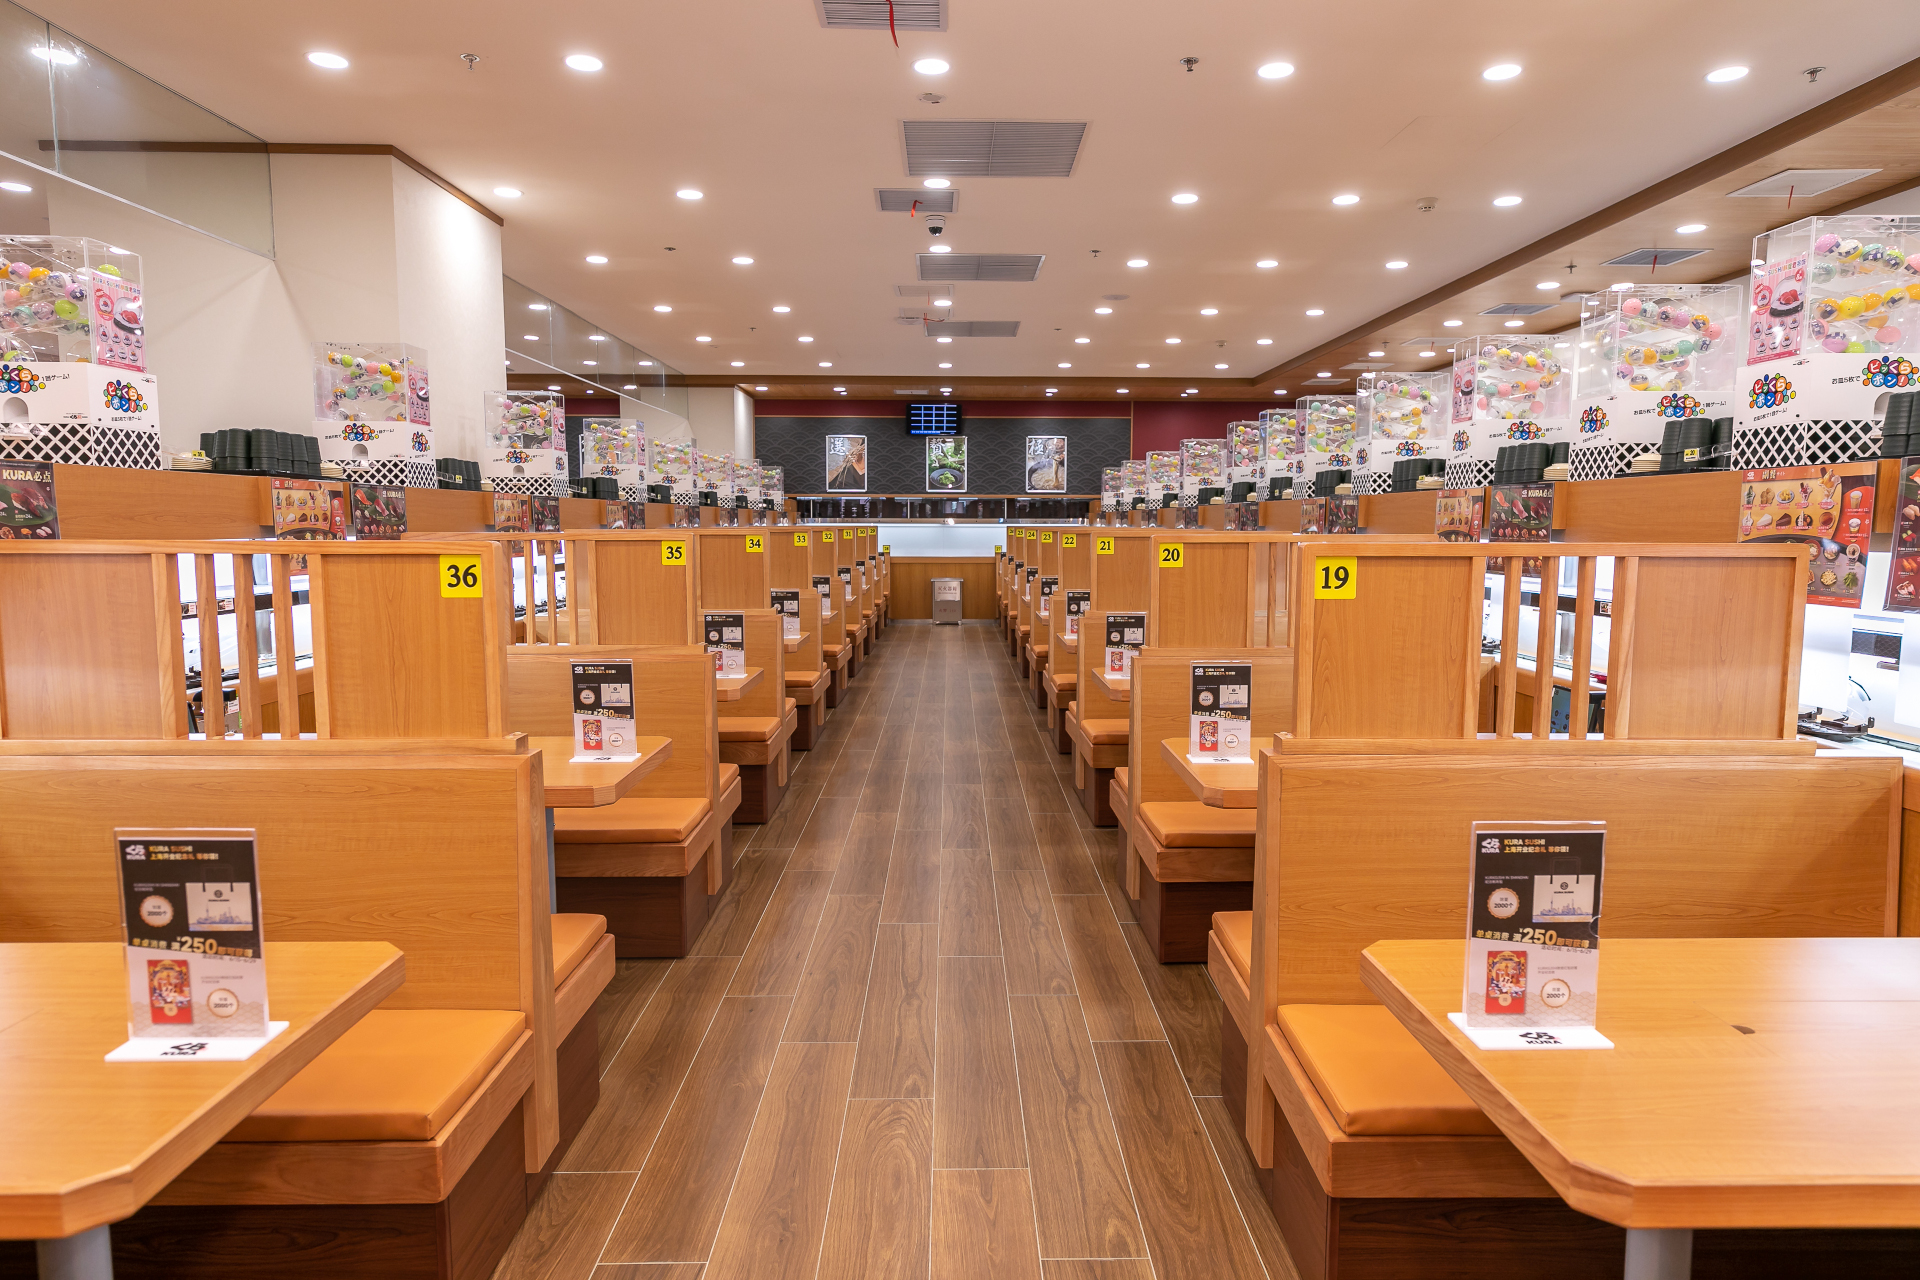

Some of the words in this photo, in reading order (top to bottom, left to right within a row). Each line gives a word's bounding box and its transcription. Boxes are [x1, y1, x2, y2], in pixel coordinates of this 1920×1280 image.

[1870, 361, 1910, 373] ビッくら
[0, 370, 32, 380] ッくら
[1832, 376, 1860, 384] お皿5枚で
[108, 384, 137, 400] ビッくら
[1755, 380, 1785, 394] ビッくら
[1664, 398, 1694, 407] ビッくら
[2, 469, 51, 482] KURA必点
[749, 539, 761, 548] 34
[1100, 541, 1111, 550] 21
[666, 546, 682, 559] 35
[1162, 548, 1180, 561] 20
[447, 564, 477, 588] 36
[1321, 566, 1349, 589] 19
[1476, 929, 1509, 941] 单桌消费
